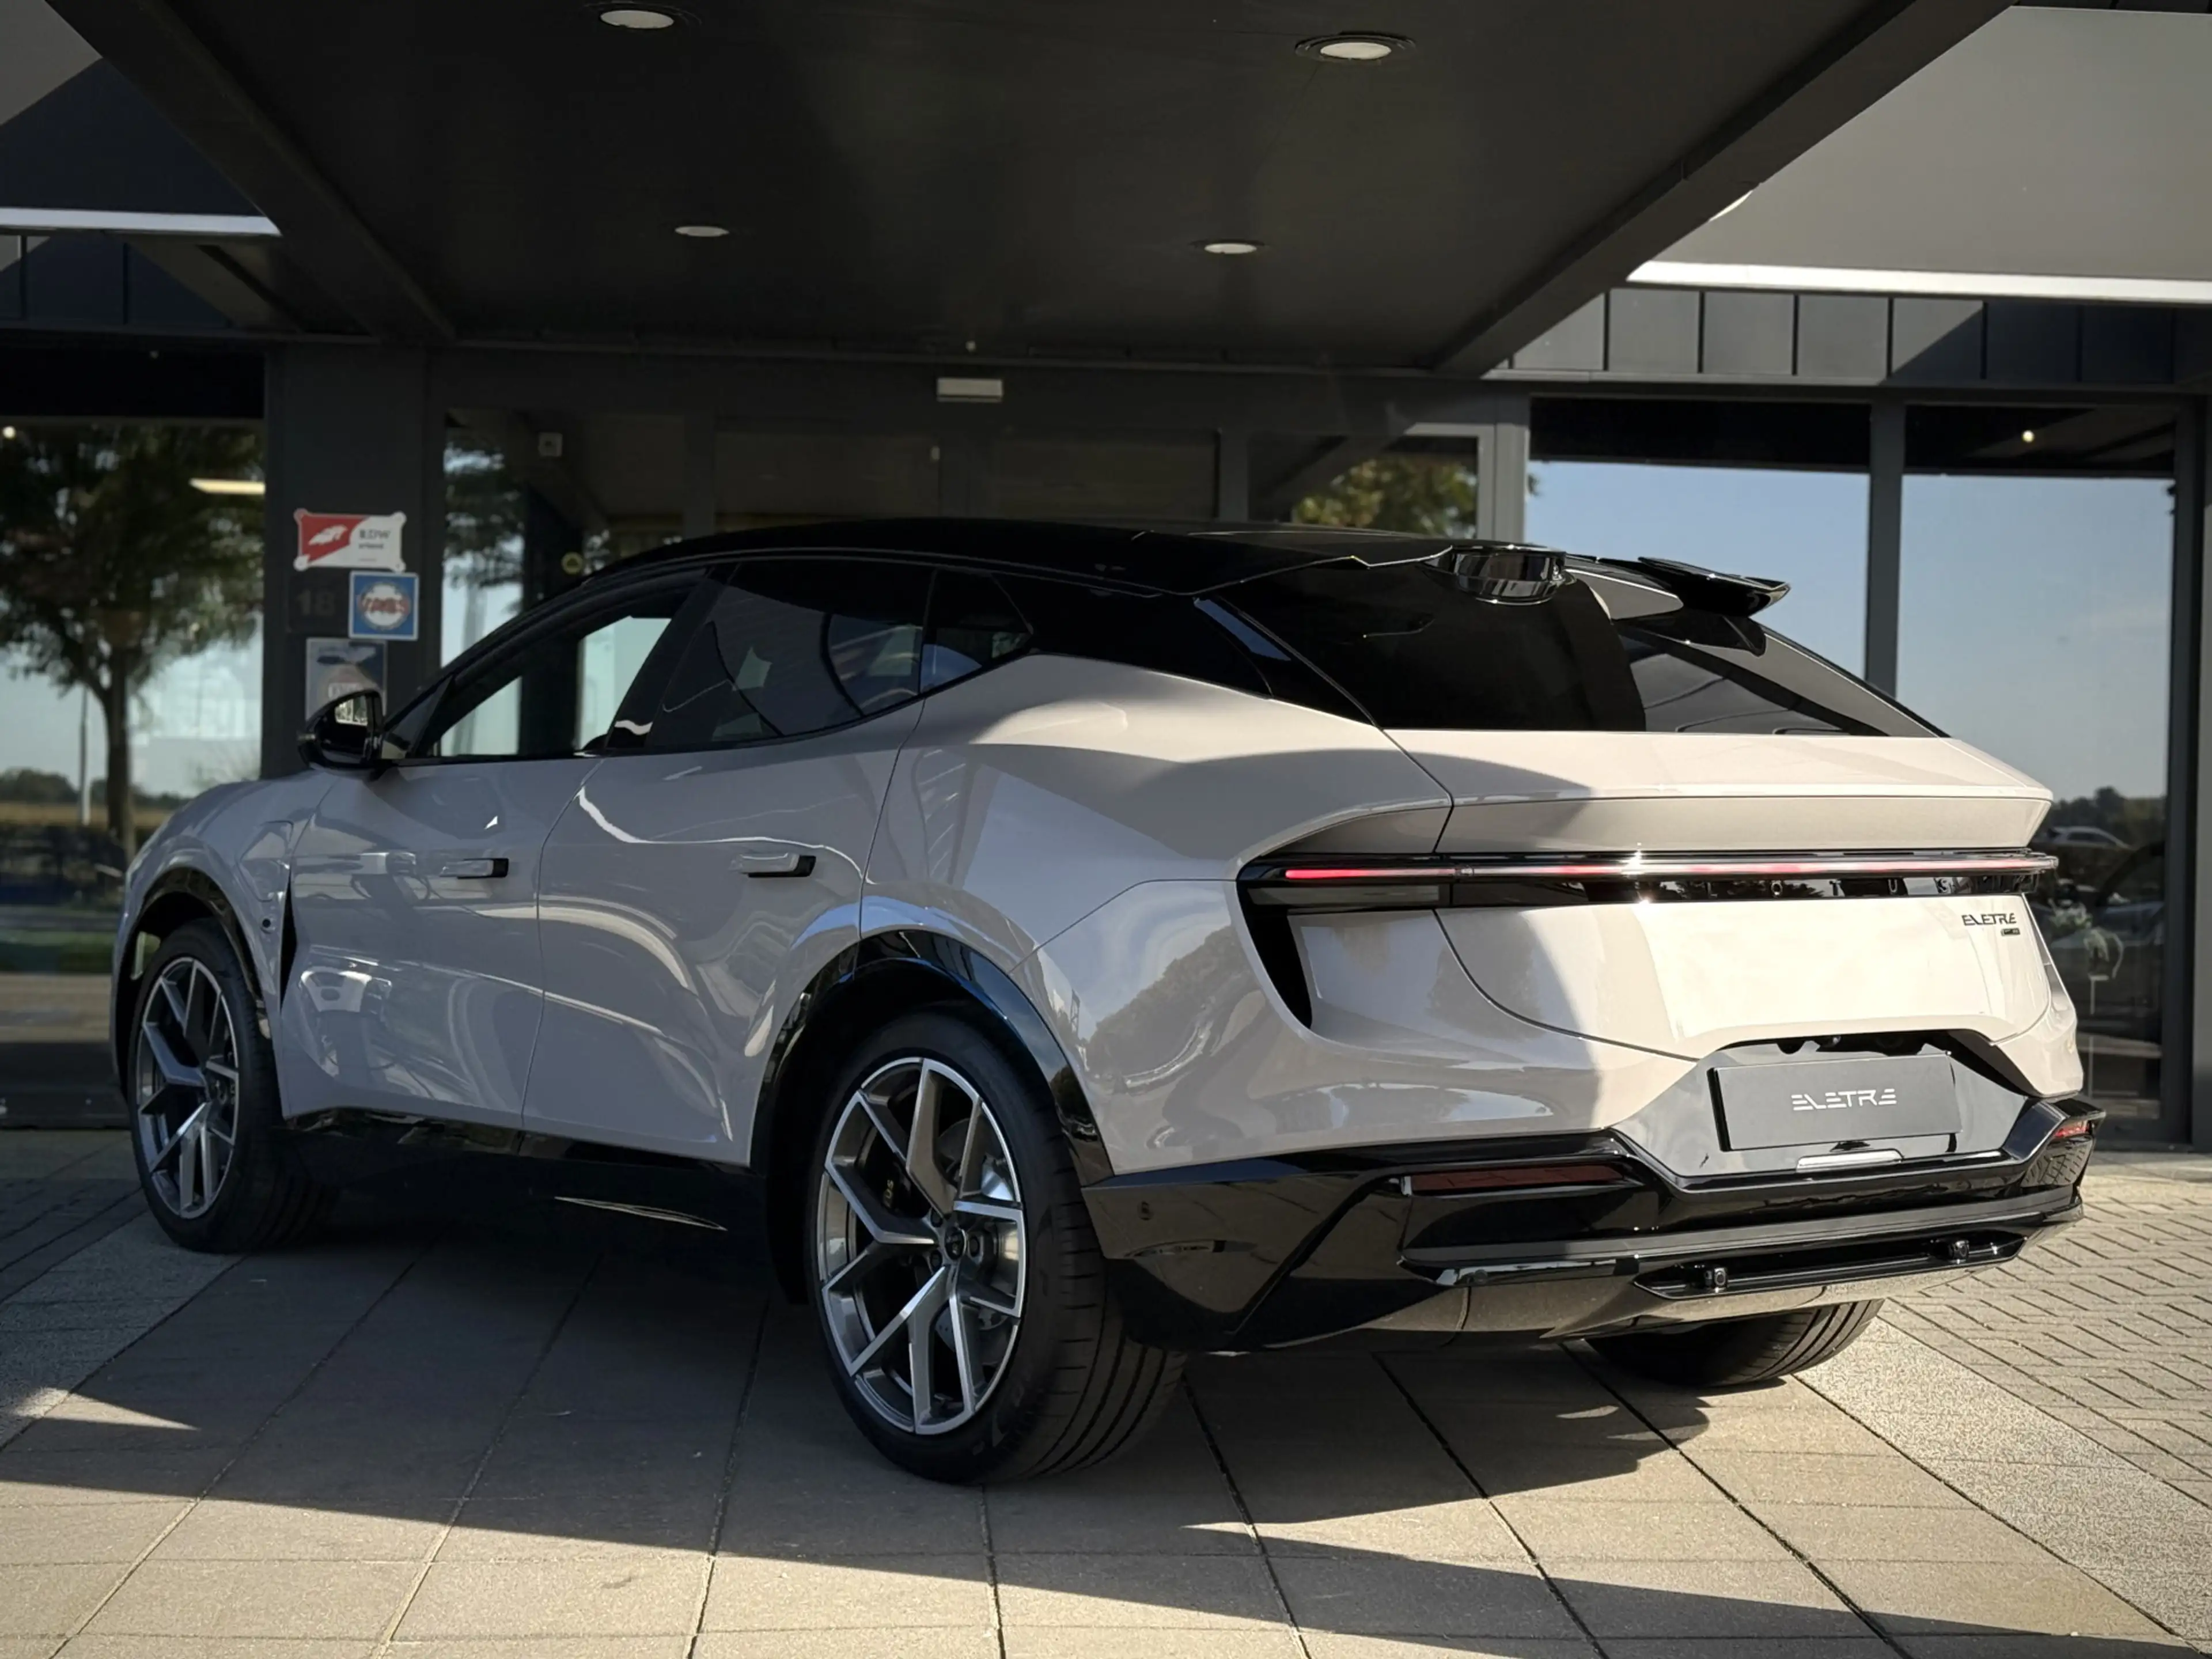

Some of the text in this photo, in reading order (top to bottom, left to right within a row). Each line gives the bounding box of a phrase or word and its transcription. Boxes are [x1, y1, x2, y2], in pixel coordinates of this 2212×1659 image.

[296, 588, 335, 616] 18
[1707, 878, 1951, 898] LOTUS
[1961, 912, 2017, 926] ELETRE
[1791, 1088, 1897, 1111] ELETRE
